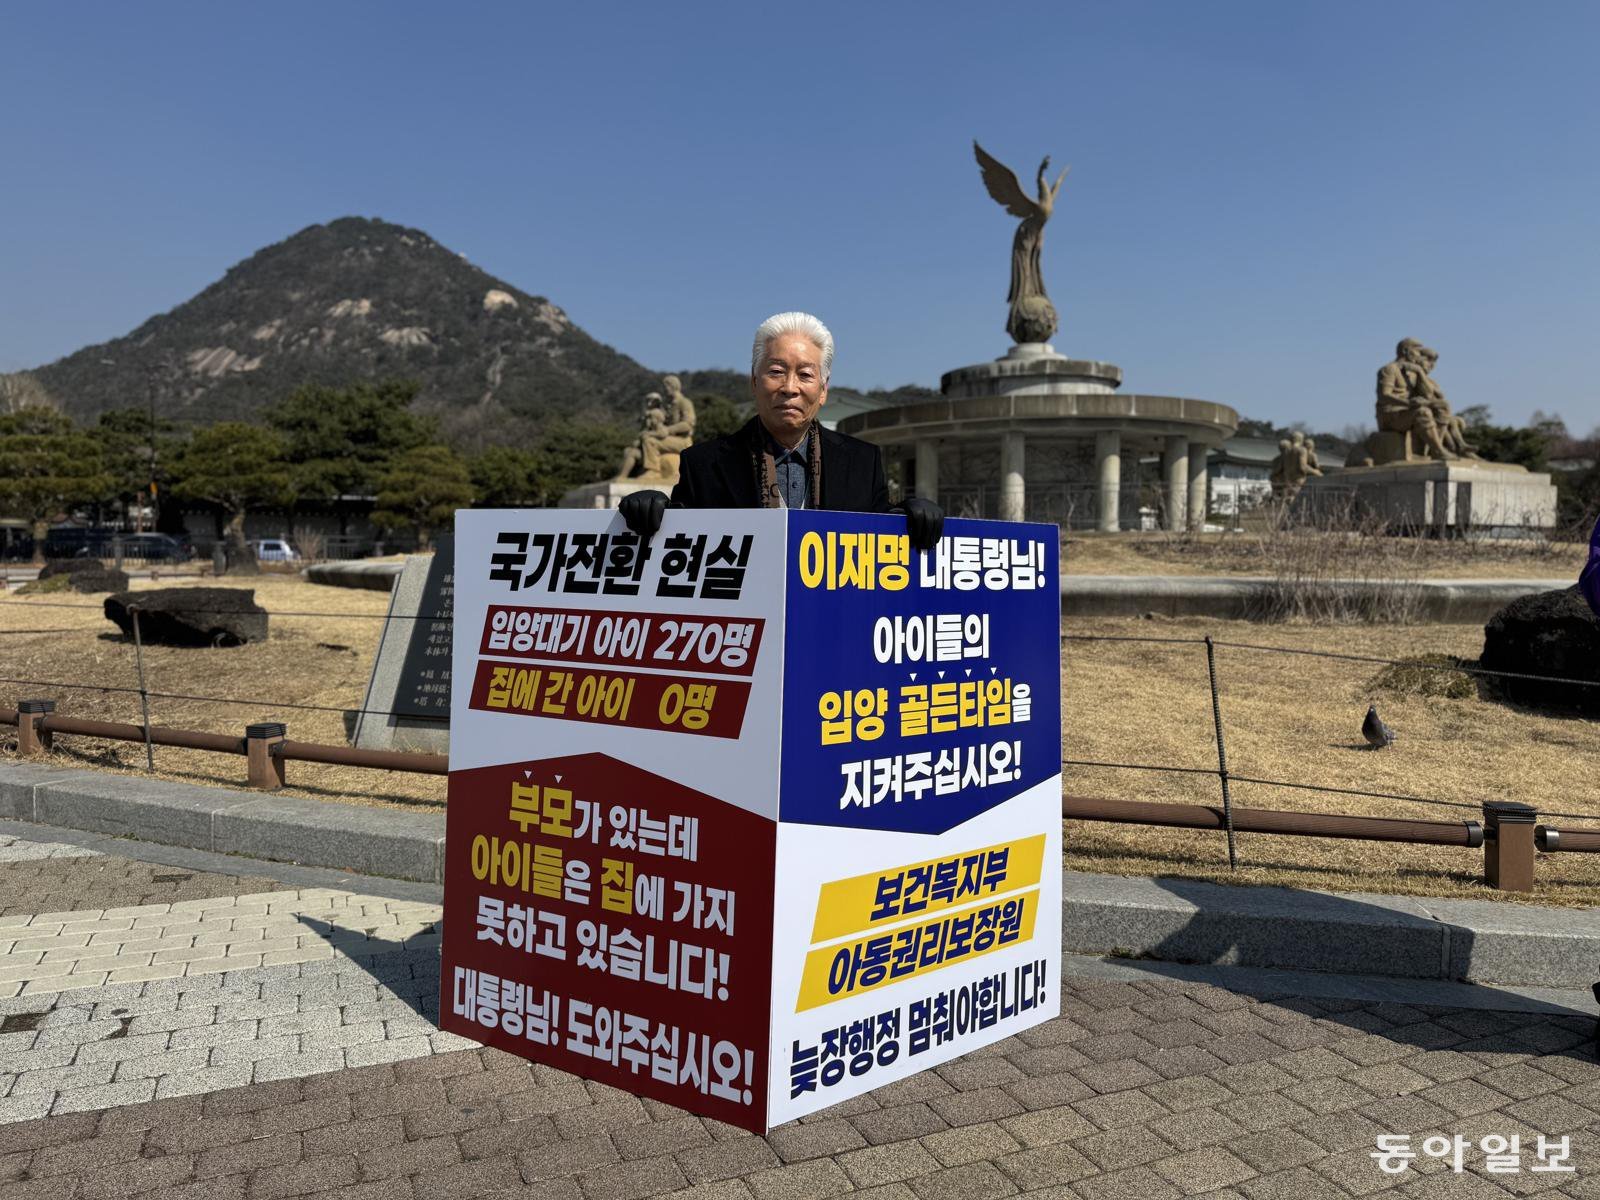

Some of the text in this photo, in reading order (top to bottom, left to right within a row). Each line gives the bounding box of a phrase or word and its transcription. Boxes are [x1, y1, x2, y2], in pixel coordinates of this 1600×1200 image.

[489, 532, 755, 600] 국가전환 현실
[799, 531, 1046, 591] 이재명 대통령님!
[488, 610, 756, 668] 입양대기 아이 270명
[873, 613, 990, 664] 아이들의
[486, 667, 718, 730] 집에 간 아이 0명
[818, 677, 1032, 746] 입양 골든타임을
[839, 740, 1022, 810] 지켜주십시오!
[509, 781, 699, 862] 부모가 있는데
[471, 834, 736, 937] 아이들은 집에 가지
[869, 847, 1010, 922] 보건복지부
[476, 895, 730, 1001] 못하고 있습니다!
[828, 898, 1024, 995] 아동권리보장원
[453, 966, 755, 1106] 대통령님! 도와주십시오!
[790, 959, 1047, 1100] 늦장행정 멈춰야합니다!
